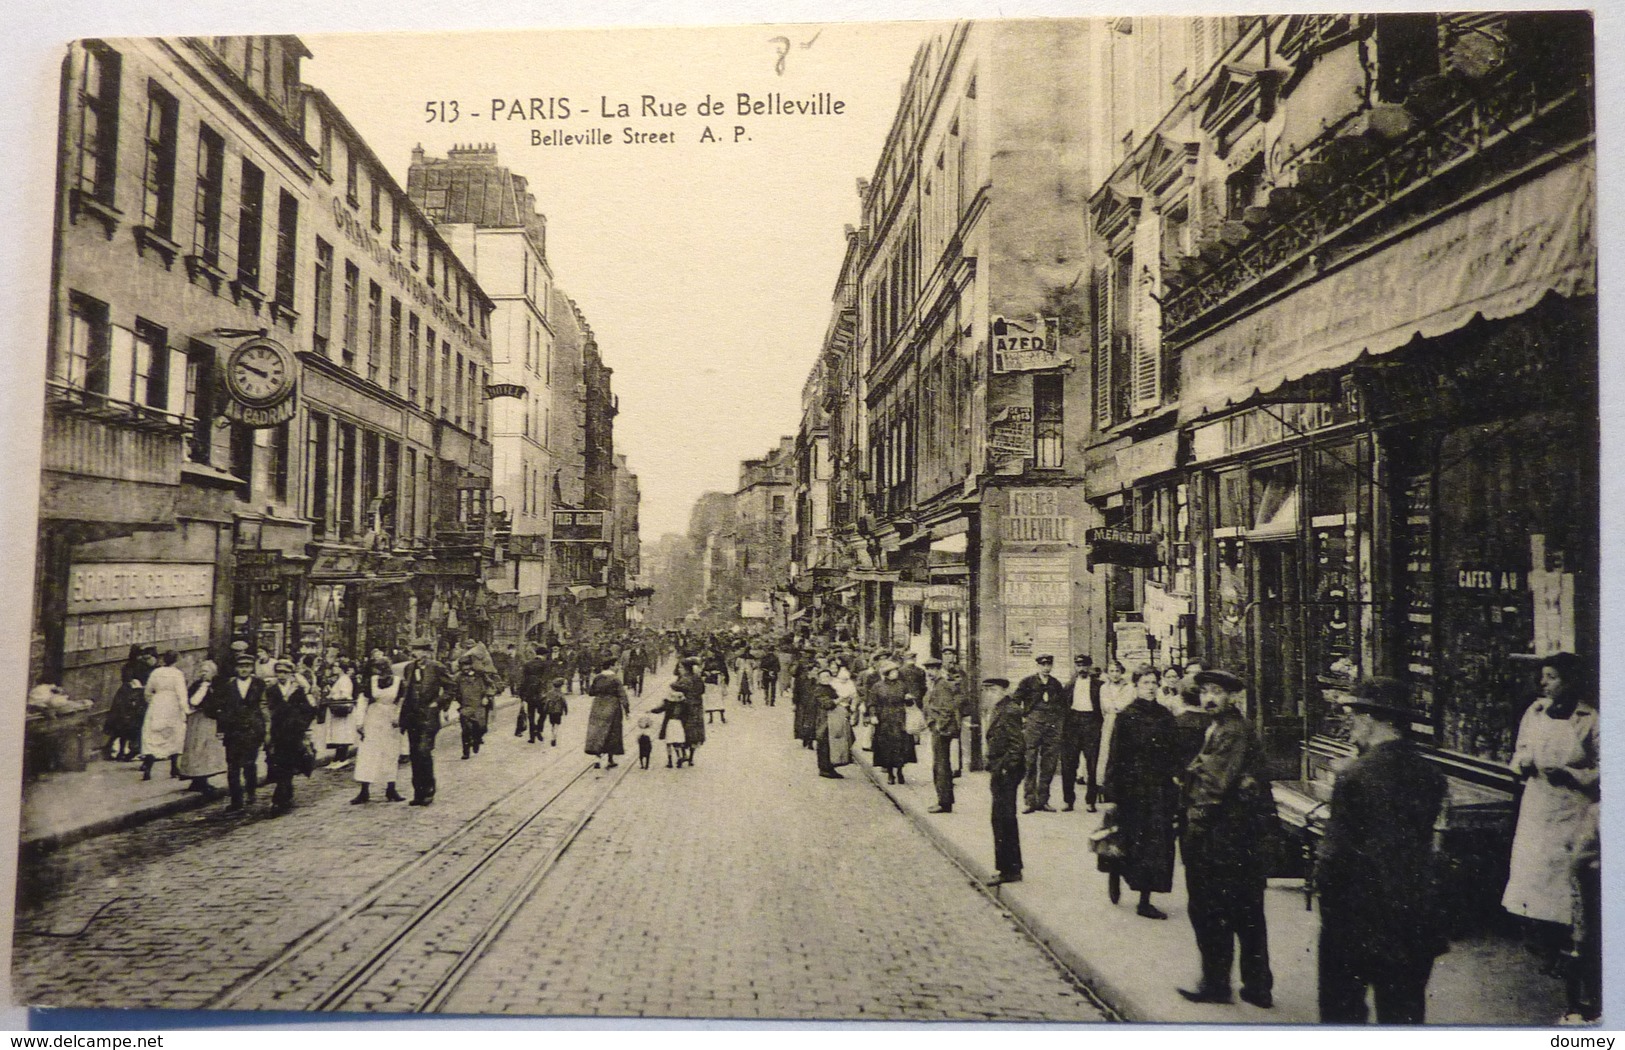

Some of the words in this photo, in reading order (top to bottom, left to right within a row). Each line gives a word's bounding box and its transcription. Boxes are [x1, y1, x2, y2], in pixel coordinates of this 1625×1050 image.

[1093, 529, 1151, 545] MERCERIE
[1458, 570, 1492, 588] CAFES
[260, 583, 280, 592] LIP
